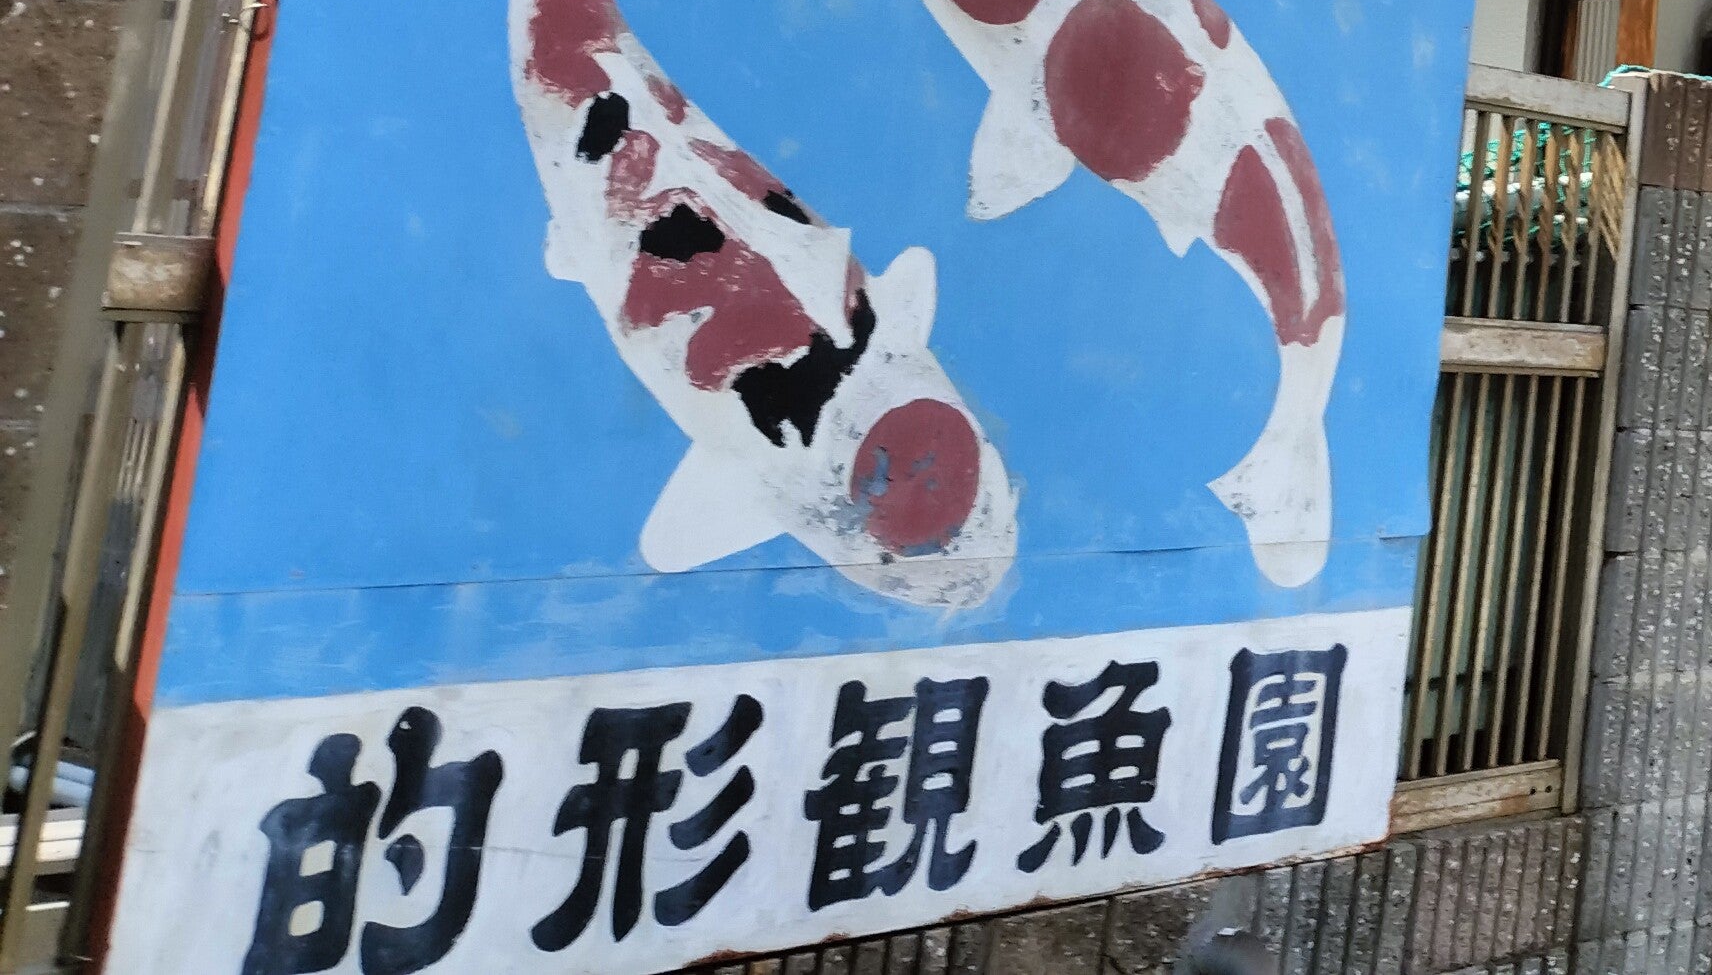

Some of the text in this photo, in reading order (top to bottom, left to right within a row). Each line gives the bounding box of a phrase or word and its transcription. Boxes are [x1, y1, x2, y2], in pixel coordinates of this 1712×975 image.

[242, 642, 1348, 975] 的形観魚園
